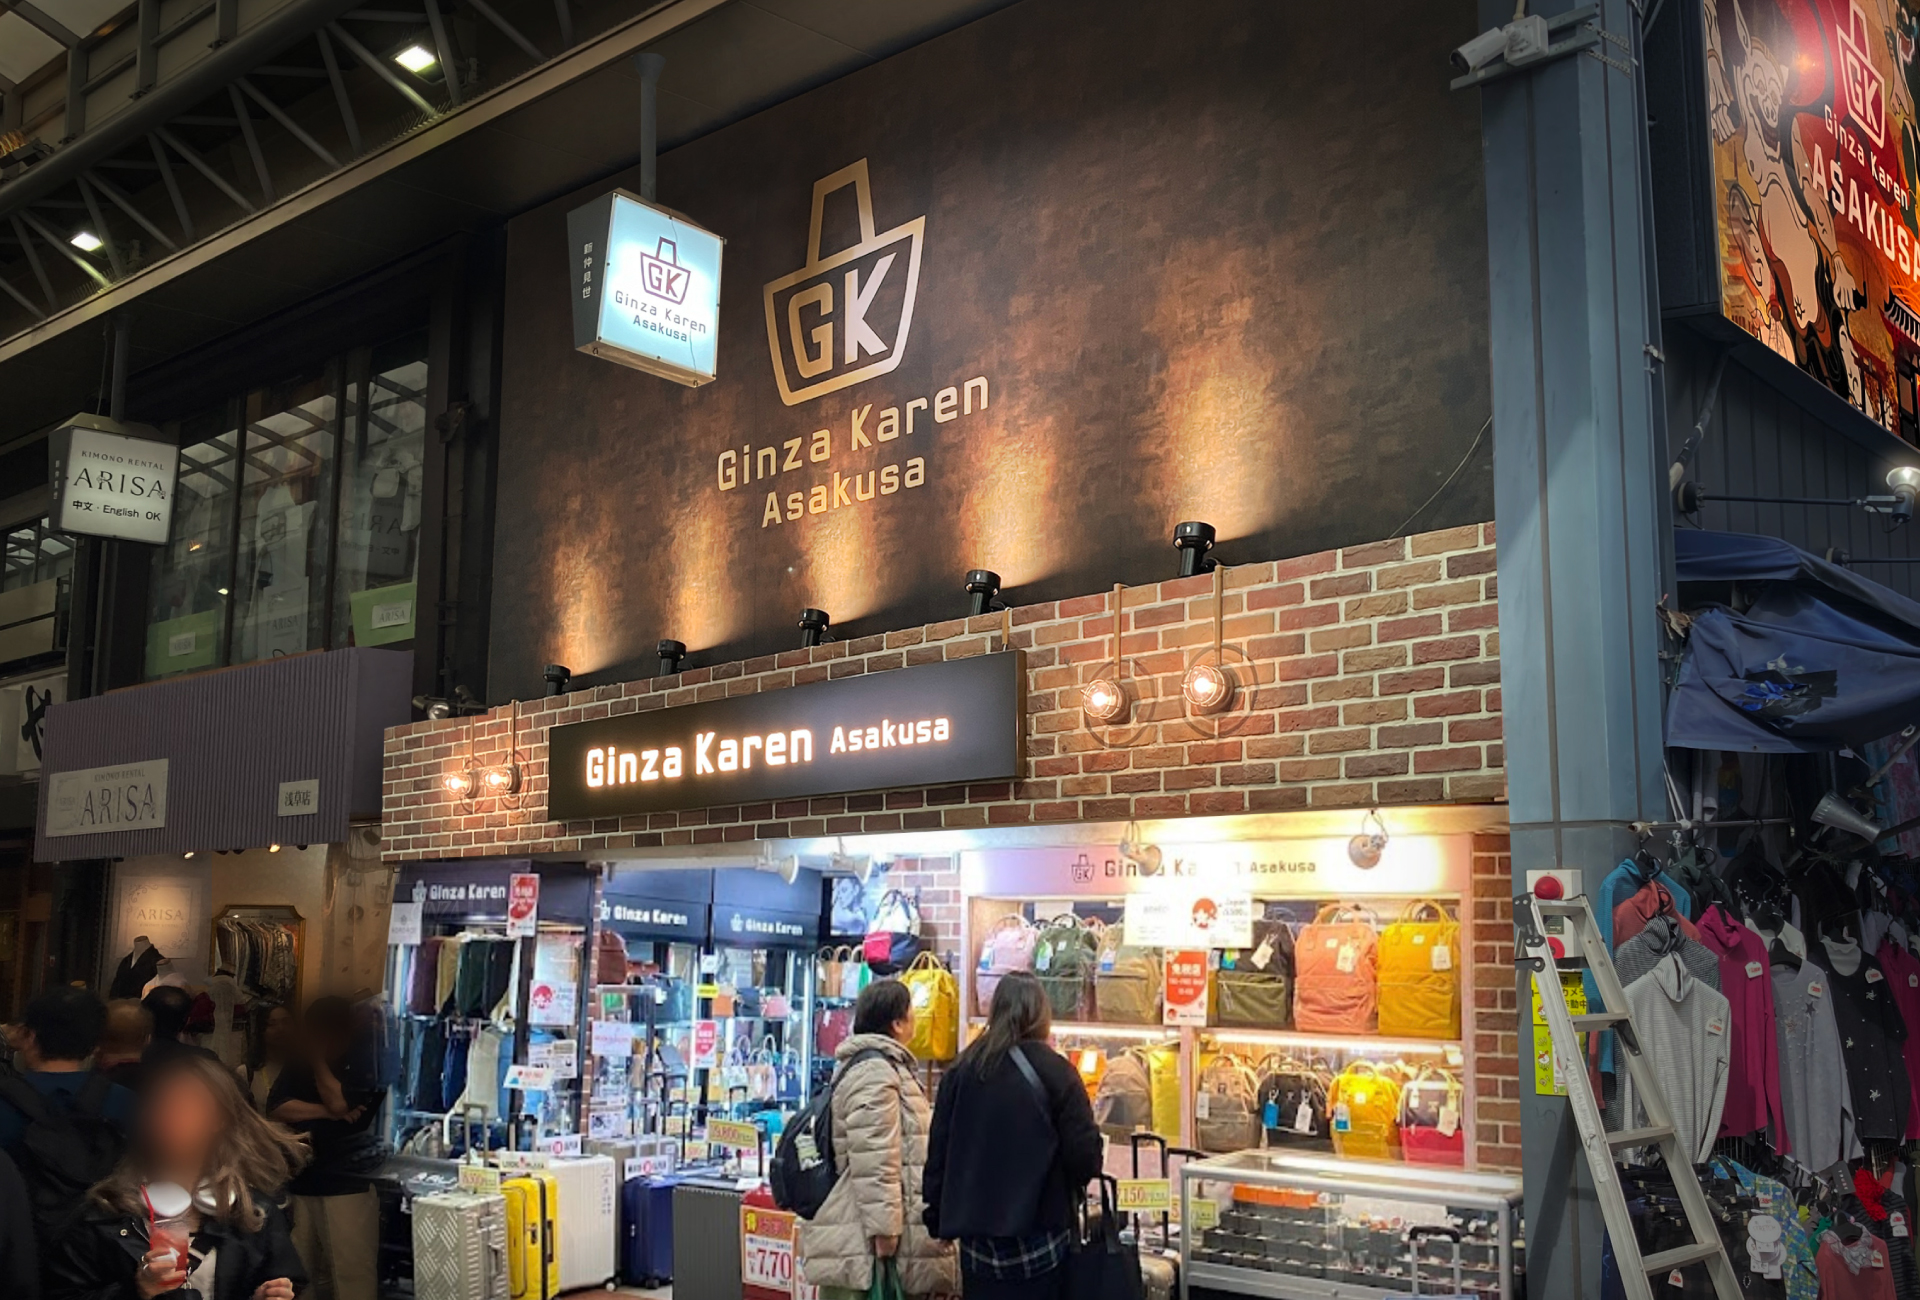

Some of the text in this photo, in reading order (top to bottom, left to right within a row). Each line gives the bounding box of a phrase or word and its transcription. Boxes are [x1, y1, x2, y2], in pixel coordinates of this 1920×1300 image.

[1846, 49, 1880, 134] GK
[1824, 103, 1909, 211] Ginza Karen
[582, 242, 593, 299] 新仲見世
[649, 262, 682, 298] GK
[615, 290, 706, 334] Ginza Karen
[787, 252, 897, 379] GK
[633, 314, 688, 342] Asakusa
[717, 375, 989, 492] Ginza Karen
[81, 450, 164, 470] KIMONO RENTAL
[73, 467, 166, 500] ARISA
[761, 456, 926, 528] Asakusa
[72, 500, 162, 521] 中文 English OK
[378, 609, 405, 622] ARISA
[586, 717, 950, 788] Ginza Karen Asakusa
[94, 769, 146, 782] KIMONO RENTAL
[80, 783, 155, 826] ARISA
[285, 790, 311, 806] 浅草店
[1250, 859, 1317, 874] Asakusa
[430, 883, 506, 900] Ginza Karen
[137, 908, 184, 921] ARISA
[614, 905, 688, 926] Ginza Karen
[745, 918, 803, 936] Ginza Karen
